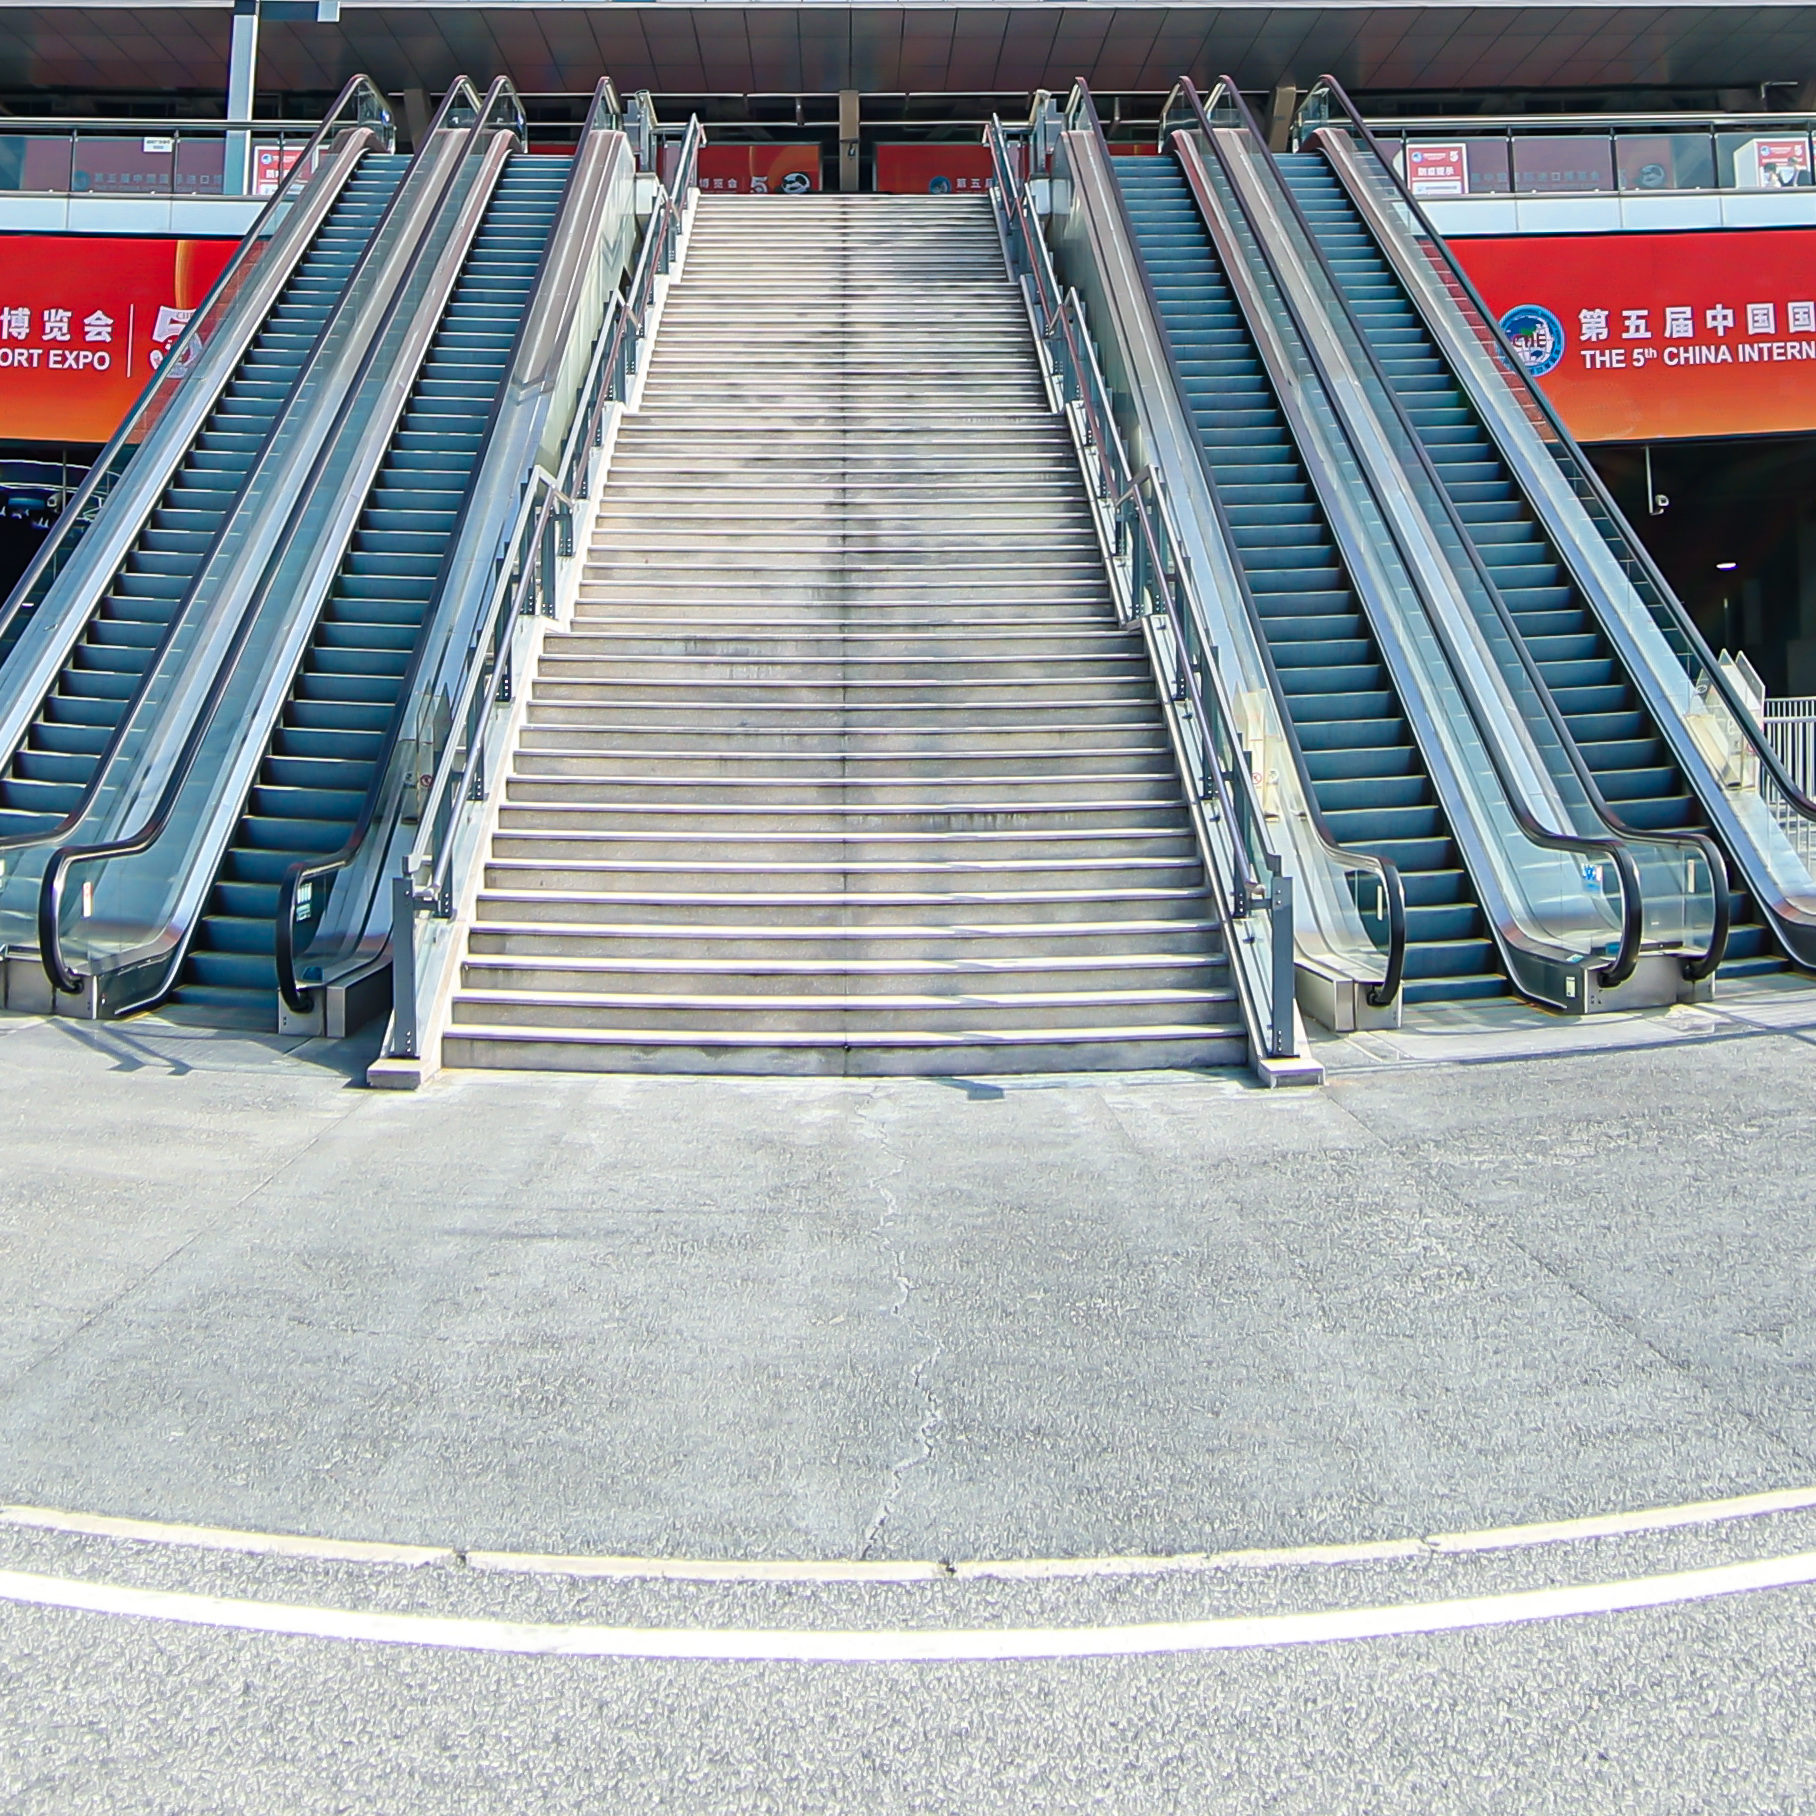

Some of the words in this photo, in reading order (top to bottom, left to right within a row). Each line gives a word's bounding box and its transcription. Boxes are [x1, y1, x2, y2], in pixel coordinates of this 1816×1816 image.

[48, 349, 111, 371] EXPO
[1580, 349, 1626, 369] THE
[1632, 347, 1658, 367] 5th
[1663, 344, 1733, 366] CHINA
